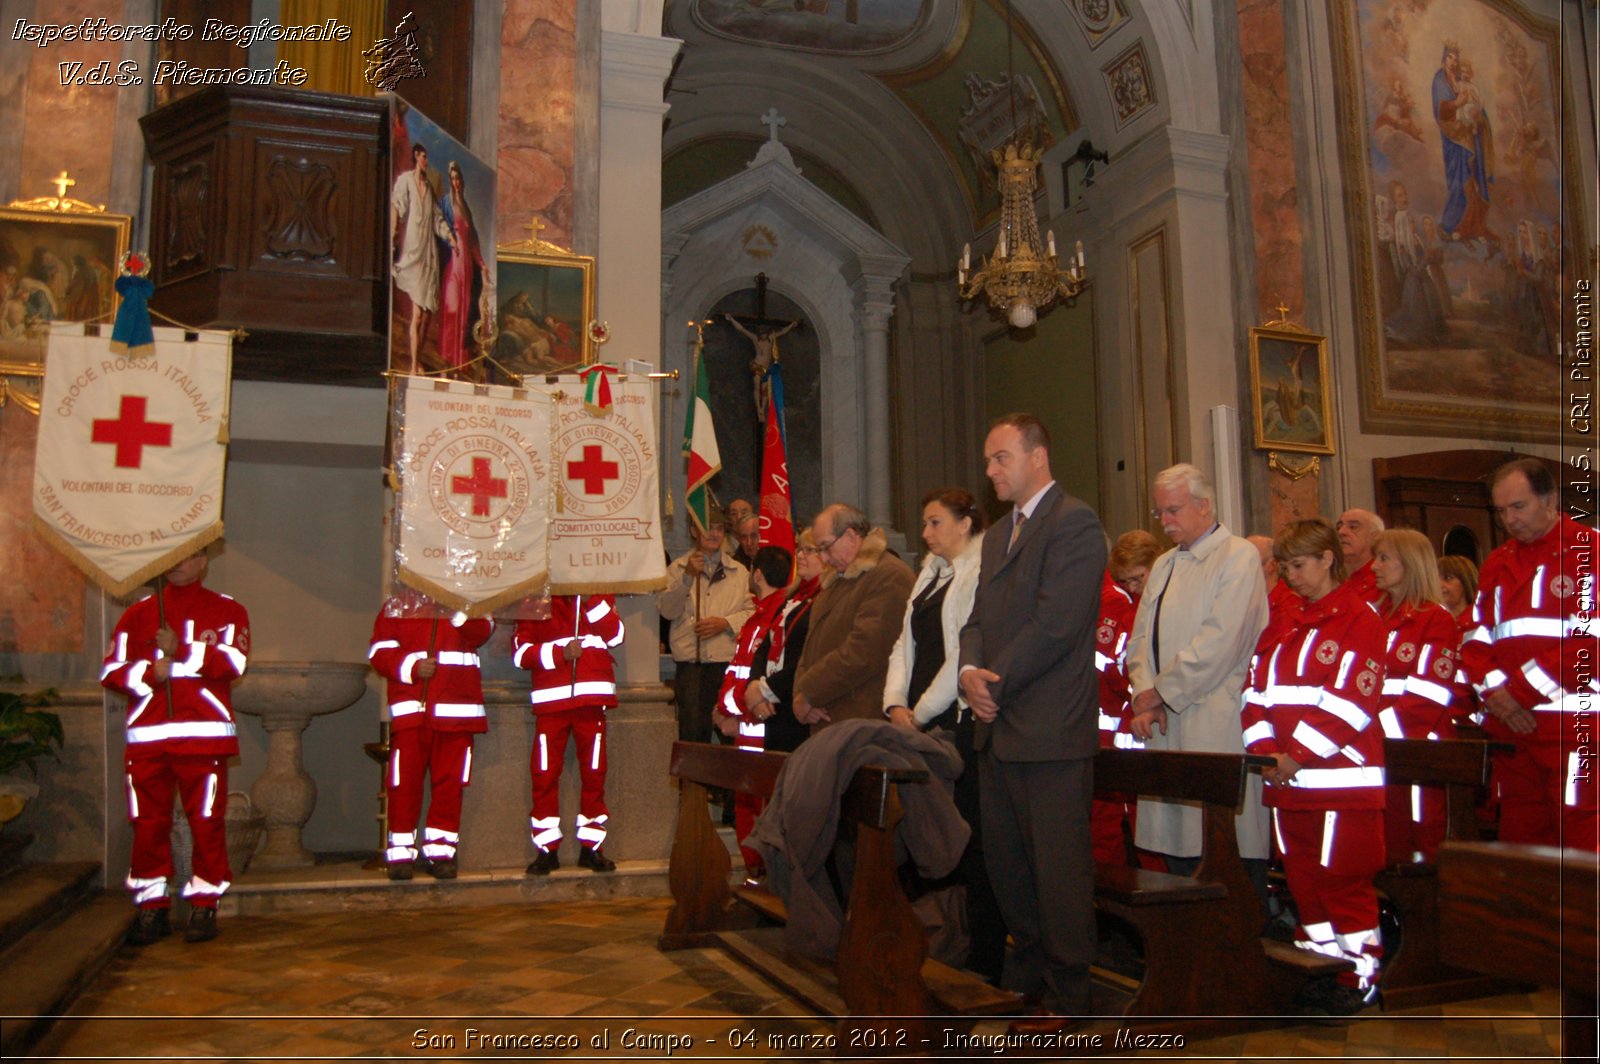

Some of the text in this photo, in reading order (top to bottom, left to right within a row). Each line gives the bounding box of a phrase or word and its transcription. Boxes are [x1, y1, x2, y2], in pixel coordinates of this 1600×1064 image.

[57, 357, 213, 425] CROCE ROSSA ITALIANA
[428, 399, 534, 420] VOLONTARI DEL SOCCORSO
[410, 415, 547, 482] CROCE ROSSA ITALIANA
[447, 444, 461, 458] DI
[463, 437, 510, 459] GINEVRA
[562, 434, 574, 447] DI
[575, 426, 621, 447] GINEVRA
[624, 458, 640, 494] AGOSTO
[61, 478, 194, 498] VOLONTARI DEL SOCCORSO
[39, 484, 214, 547] SAN FRANCESCO AL CAMPO
[557, 521, 638, 534] COMITATO LOCALE
[591, 537, 605, 548] DI
[486, 551, 527, 562] LOCALE
